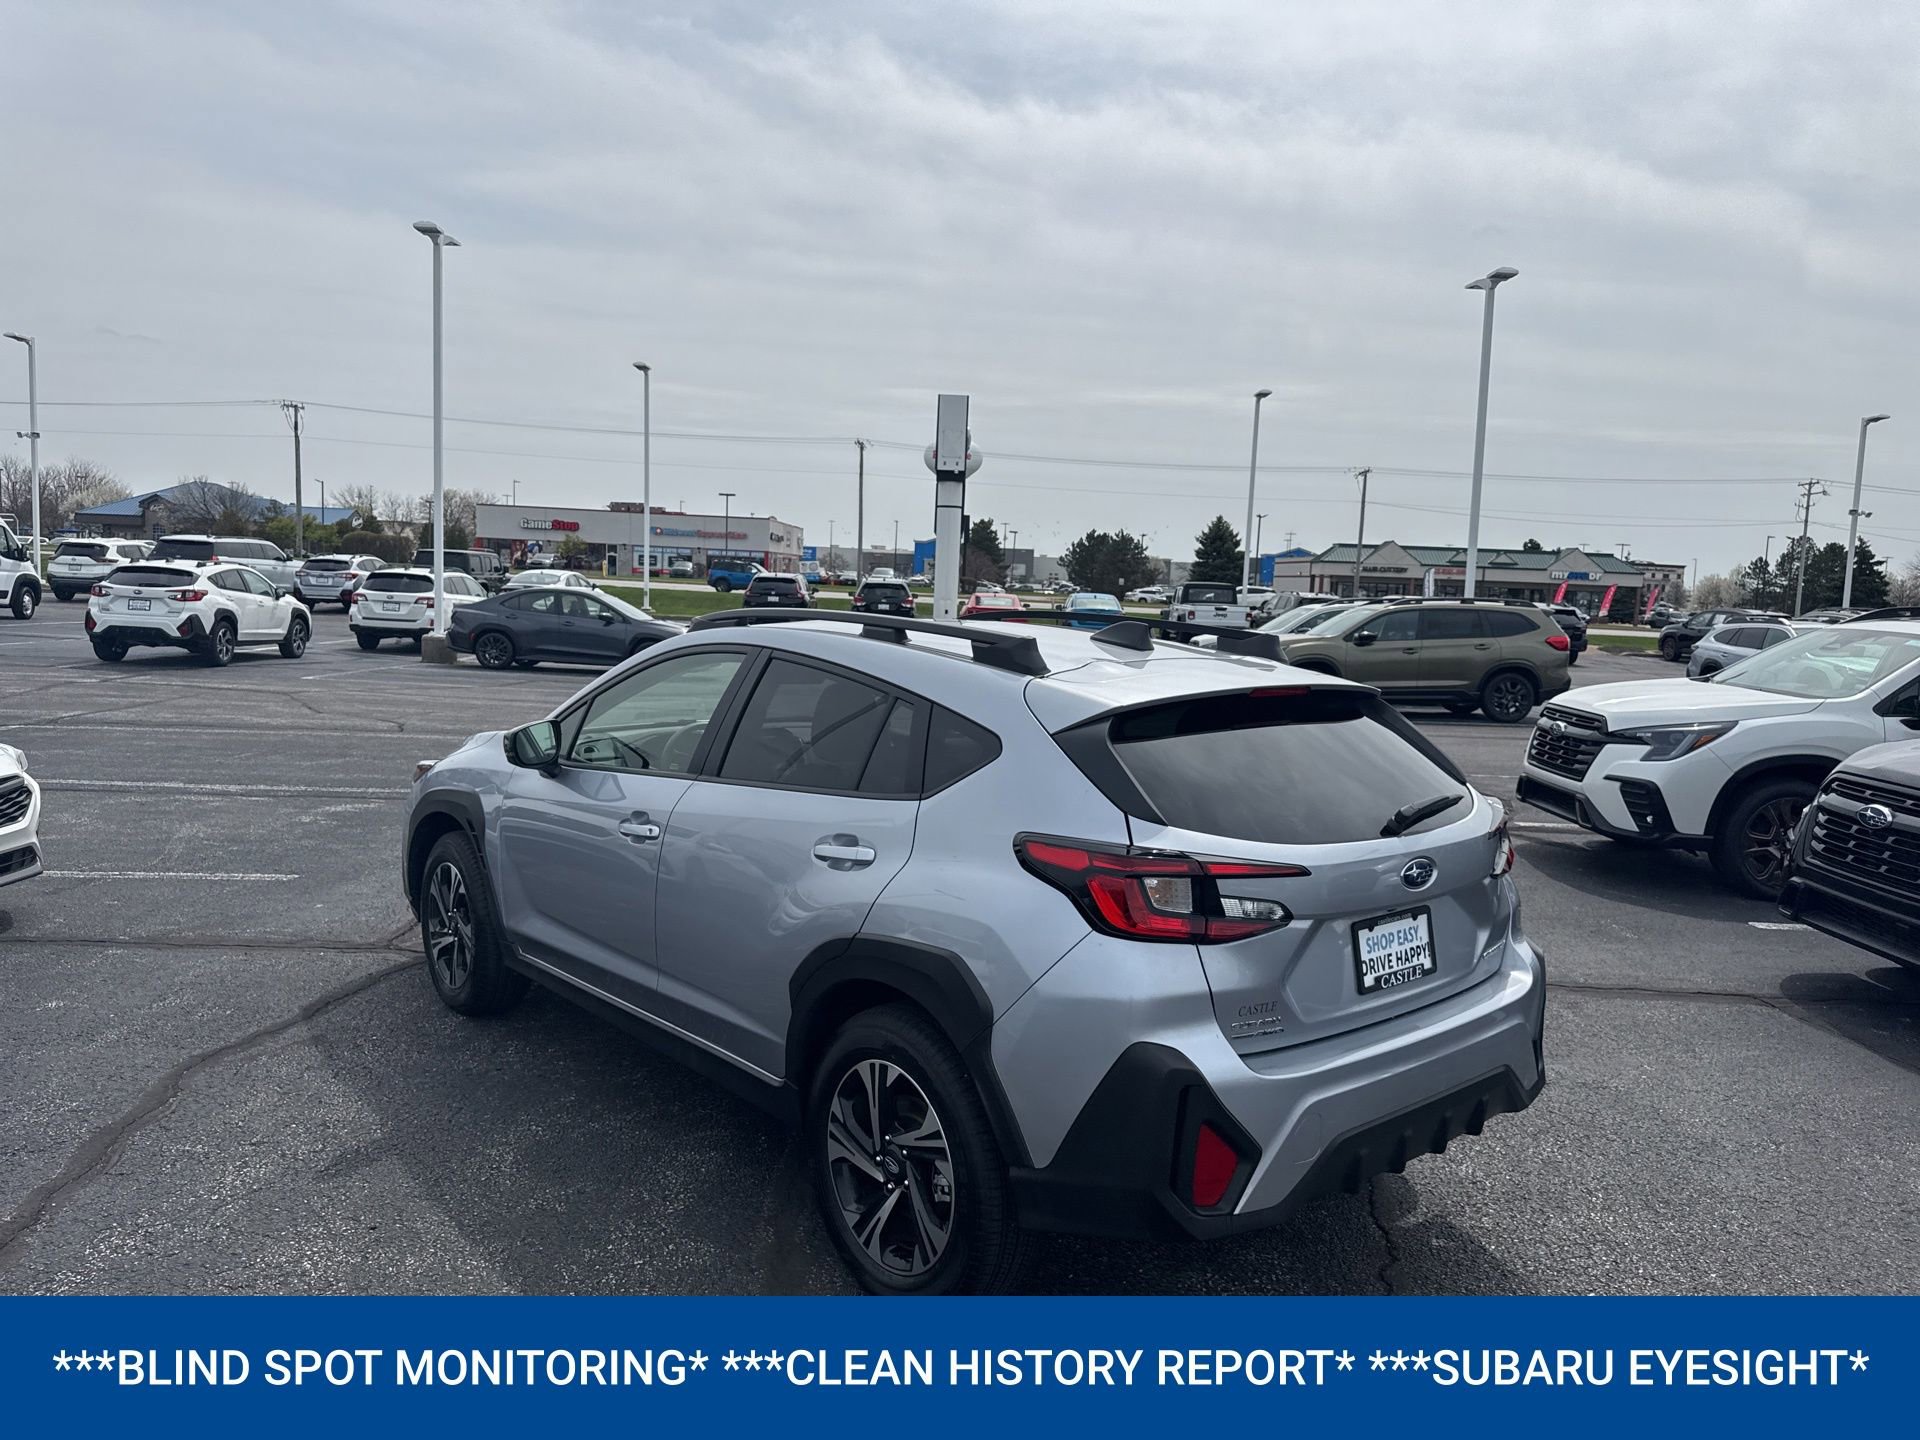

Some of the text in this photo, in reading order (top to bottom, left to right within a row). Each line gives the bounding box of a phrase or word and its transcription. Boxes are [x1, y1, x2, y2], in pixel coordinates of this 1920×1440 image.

[520, 518, 580, 532] GameStop
[1365, 925, 1423, 954] SHOP EASY,
[1361, 941, 1431, 977] DRIVE HAPPY!
[1381, 965, 1423, 989] CASTLE
[1238, 1001, 1278, 1017] CASTLE
